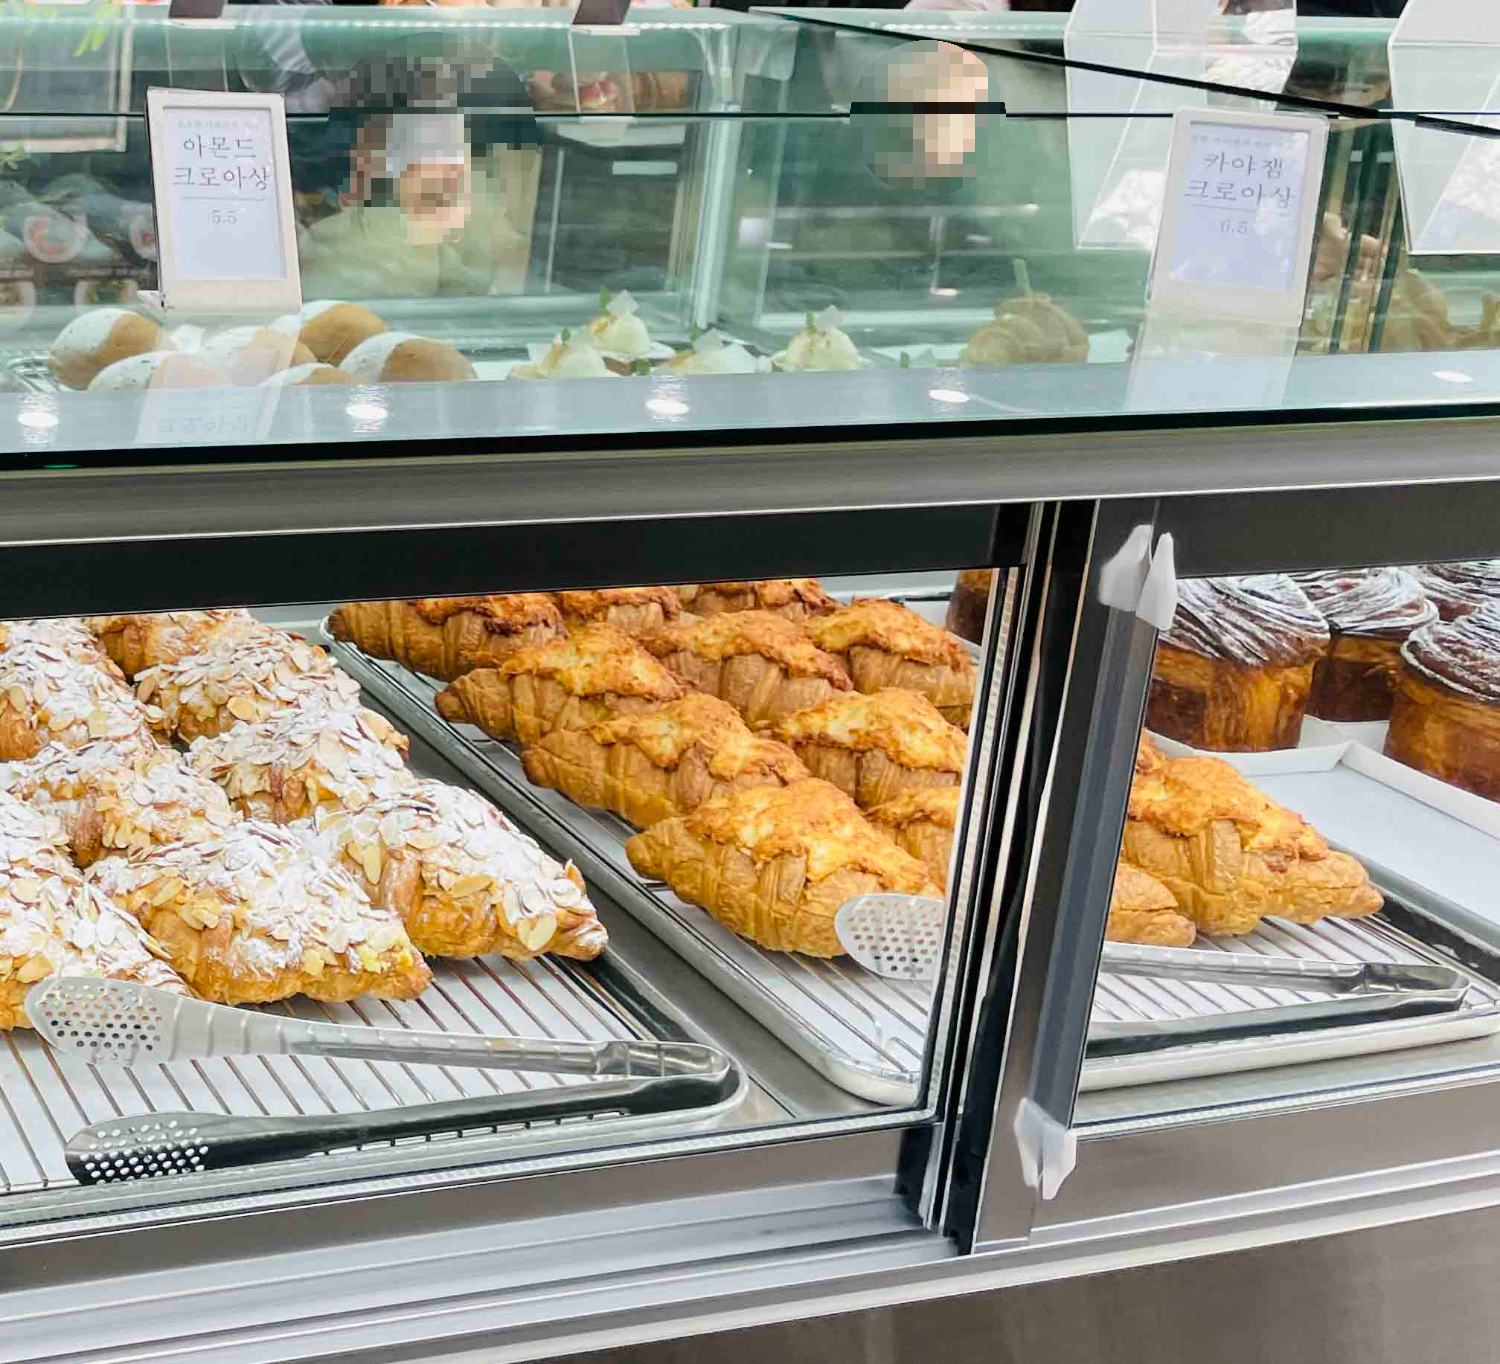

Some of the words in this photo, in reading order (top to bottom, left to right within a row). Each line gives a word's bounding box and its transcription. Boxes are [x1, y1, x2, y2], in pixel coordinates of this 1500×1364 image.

[182, 134, 257, 159] 아몬드
[172, 165, 271, 191] 크로아상
[1183, 179, 1298, 209] 크로아상
